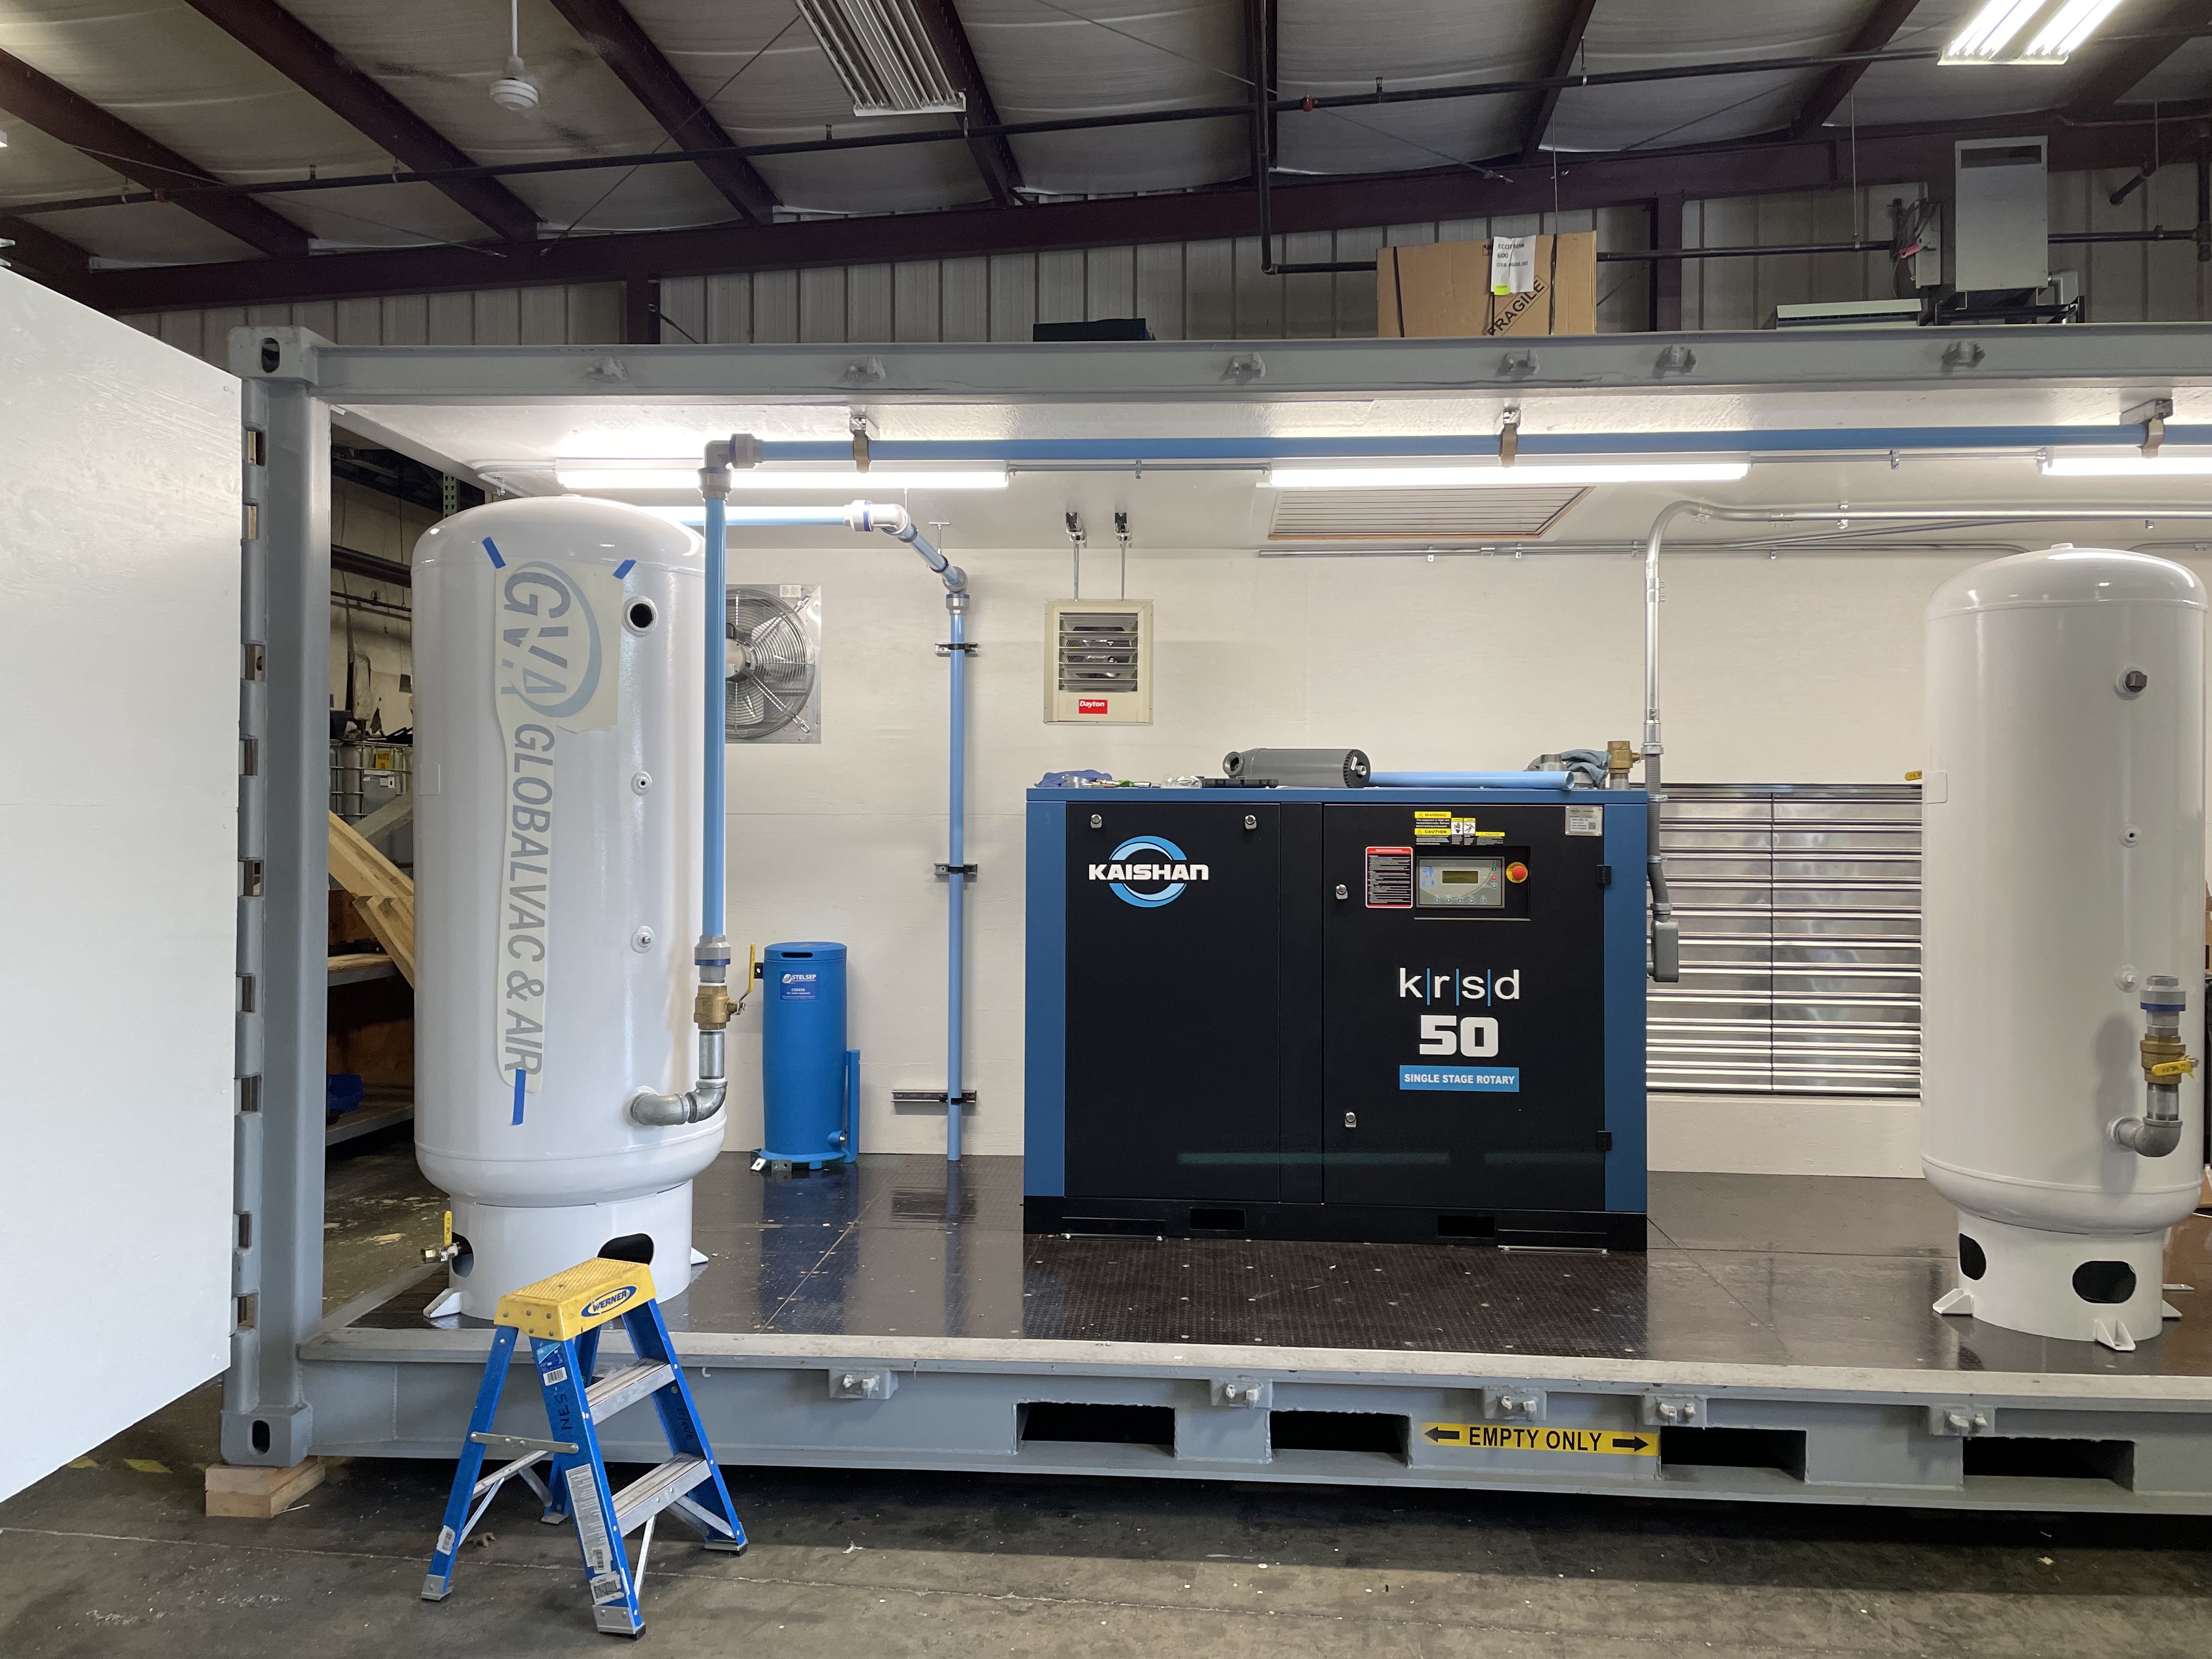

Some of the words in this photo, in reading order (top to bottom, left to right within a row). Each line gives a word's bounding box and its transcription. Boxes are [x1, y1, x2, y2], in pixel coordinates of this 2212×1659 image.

[1487, 279, 1545, 336] FRAGILE
[1088, 864, 1209, 881] KAISHAN
[506, 970, 544, 1002] &
[504, 1008, 543, 1075] AIR
[1419, 1014, 1499, 1058] 50
[1404, 1073, 1440, 1083] SINGLE
[1442, 1074, 1474, 1084] STAGE
[1476, 1075, 1515, 1085] ROTARY
[592, 1289, 628, 1312] WERNER
[1469, 1426, 1539, 1449] EMPTY
[1546, 1430, 1602, 1452] ONLY
